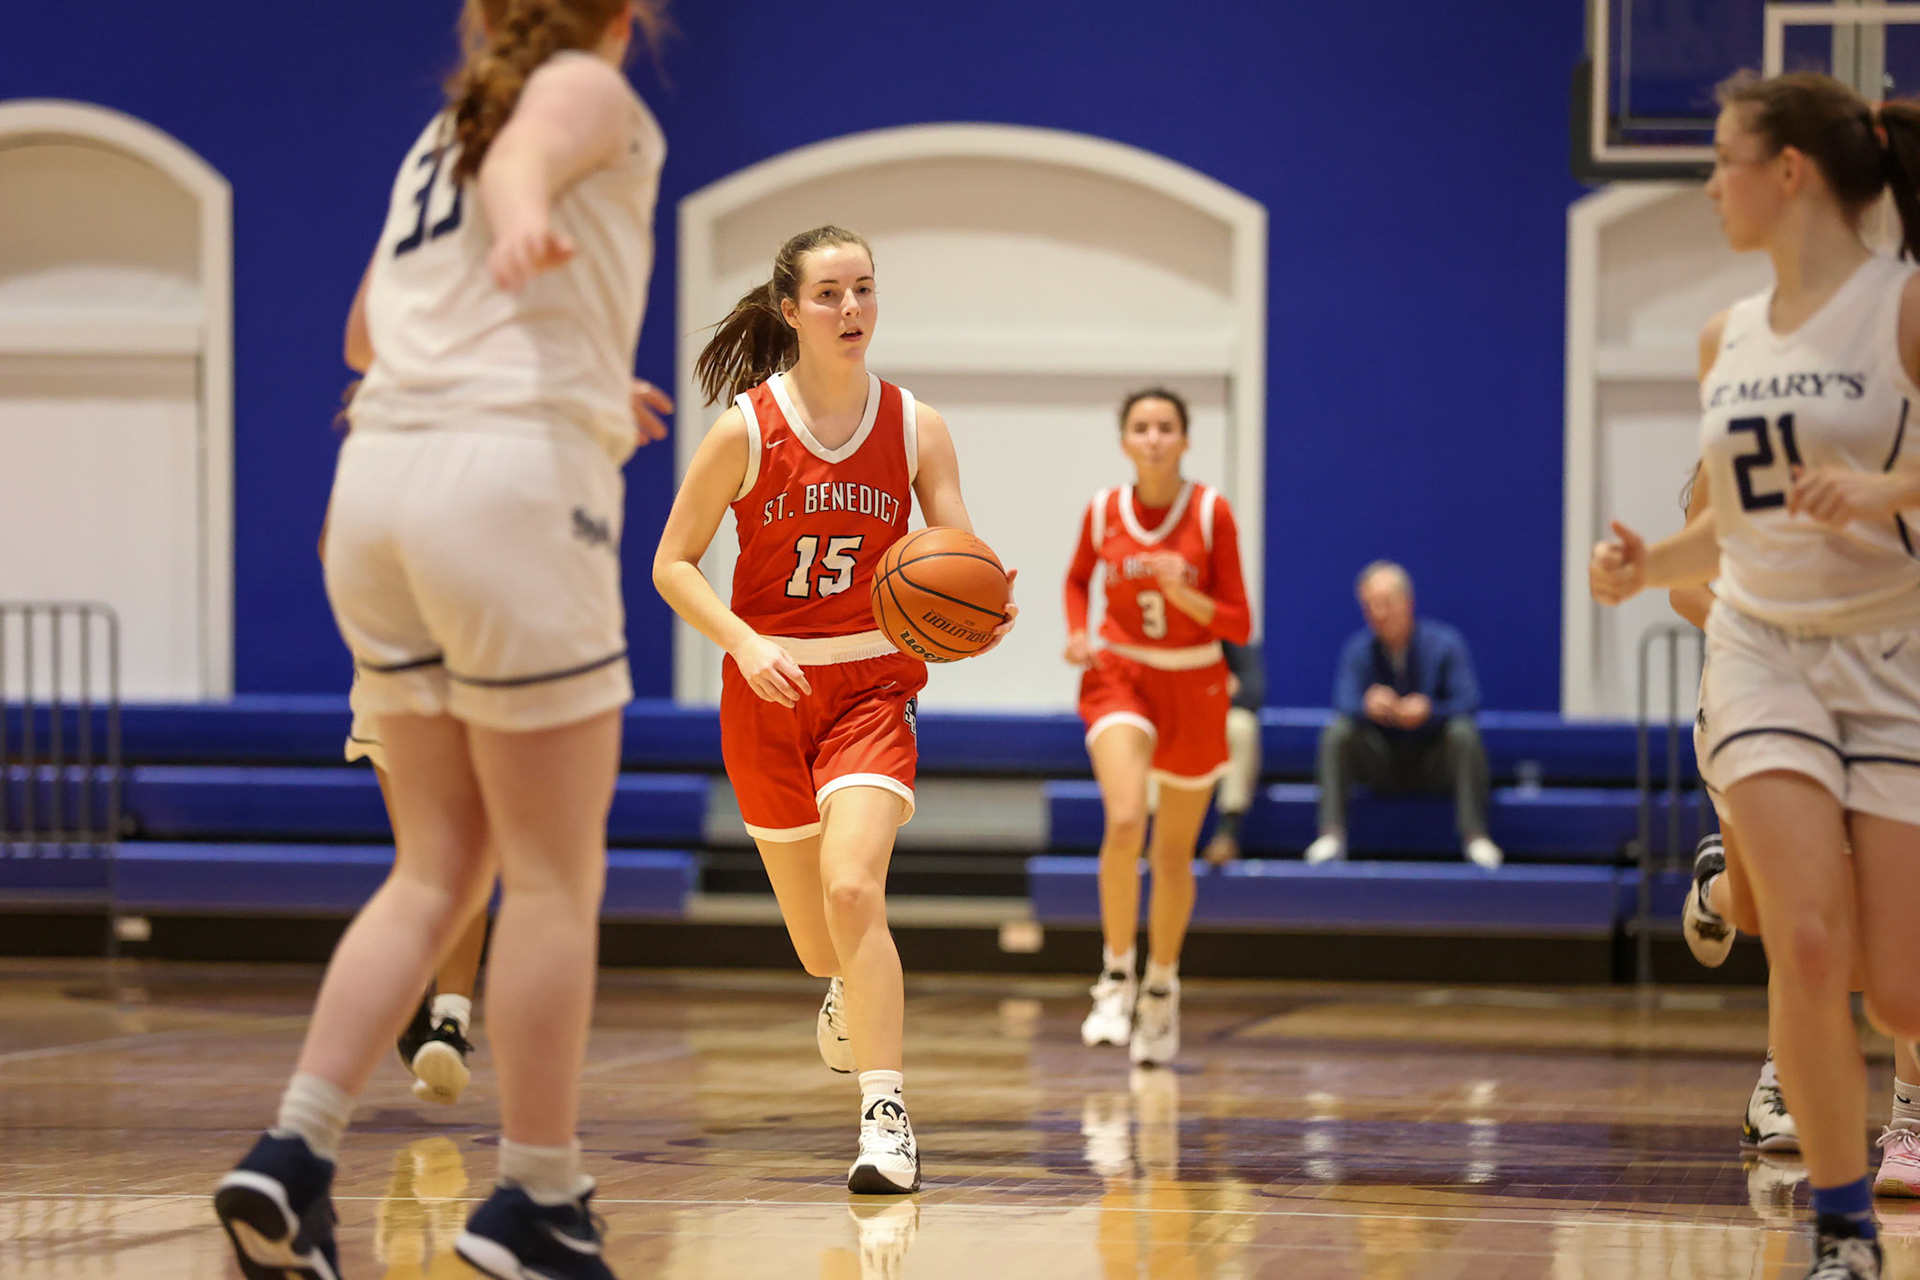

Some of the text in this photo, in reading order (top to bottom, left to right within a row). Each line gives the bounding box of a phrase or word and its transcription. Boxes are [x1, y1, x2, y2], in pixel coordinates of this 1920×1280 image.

[1732, 372, 1866, 404] MARY'S
[1727, 412, 1803, 514] 21
[762, 481, 901, 528] ST. BENEDICT
[784, 534, 866, 600] 15
[1136, 590, 1168, 640] 3
